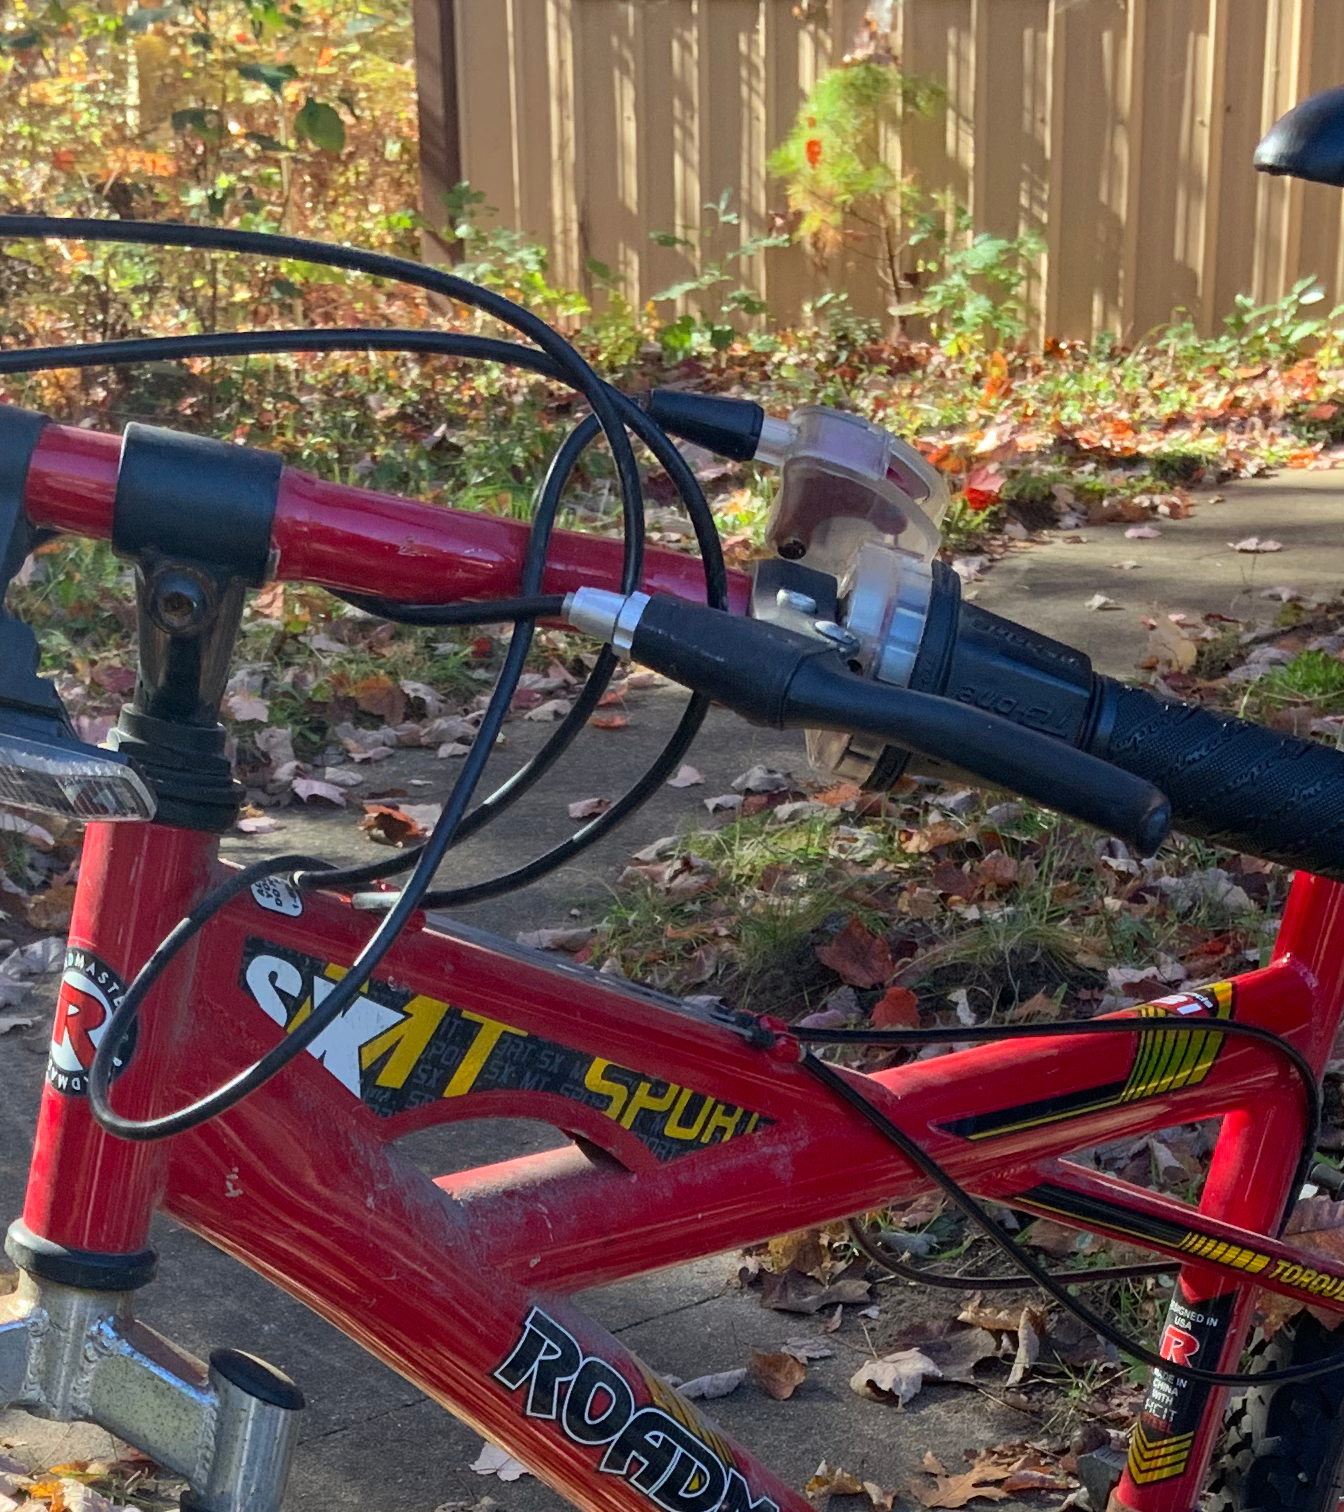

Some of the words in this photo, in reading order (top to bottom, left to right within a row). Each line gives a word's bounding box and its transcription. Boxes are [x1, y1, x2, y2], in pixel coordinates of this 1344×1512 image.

[52, 979, 107, 1070] R
[1174, 1315, 1192, 1331] USA
[1206, 1316, 1219, 1327] IN
[1159, 1324, 1200, 1368] R
[1153, 1378, 1178, 1397] CHINA
[1176, 1377, 1188, 1389] IN
[1152, 1388, 1174, 1406] WITH
